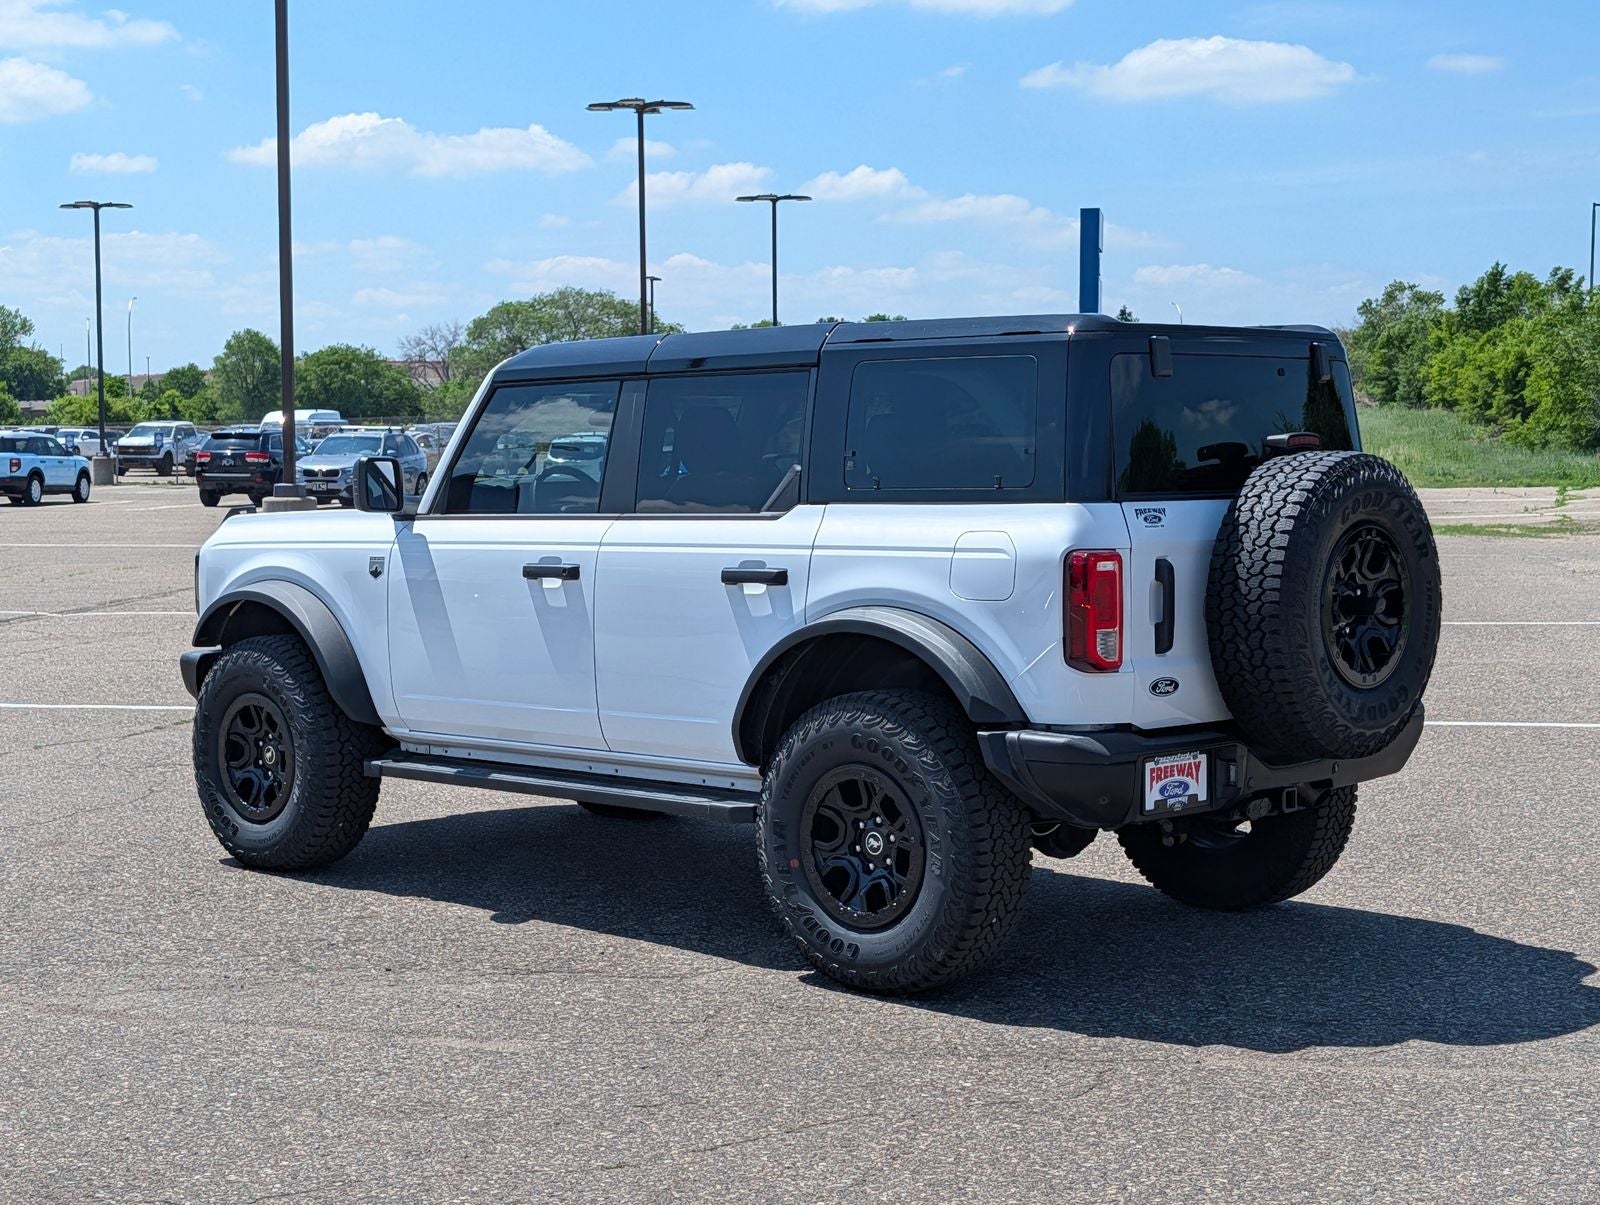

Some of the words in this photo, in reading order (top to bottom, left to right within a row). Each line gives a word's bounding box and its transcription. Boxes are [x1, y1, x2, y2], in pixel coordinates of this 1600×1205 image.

[1134, 507, 1166, 520] FREEWAY
[1154, 679, 1176, 694] Ford
[1149, 760, 1201, 795] FREEWAY
[1163, 782, 1186, 797] Ford
